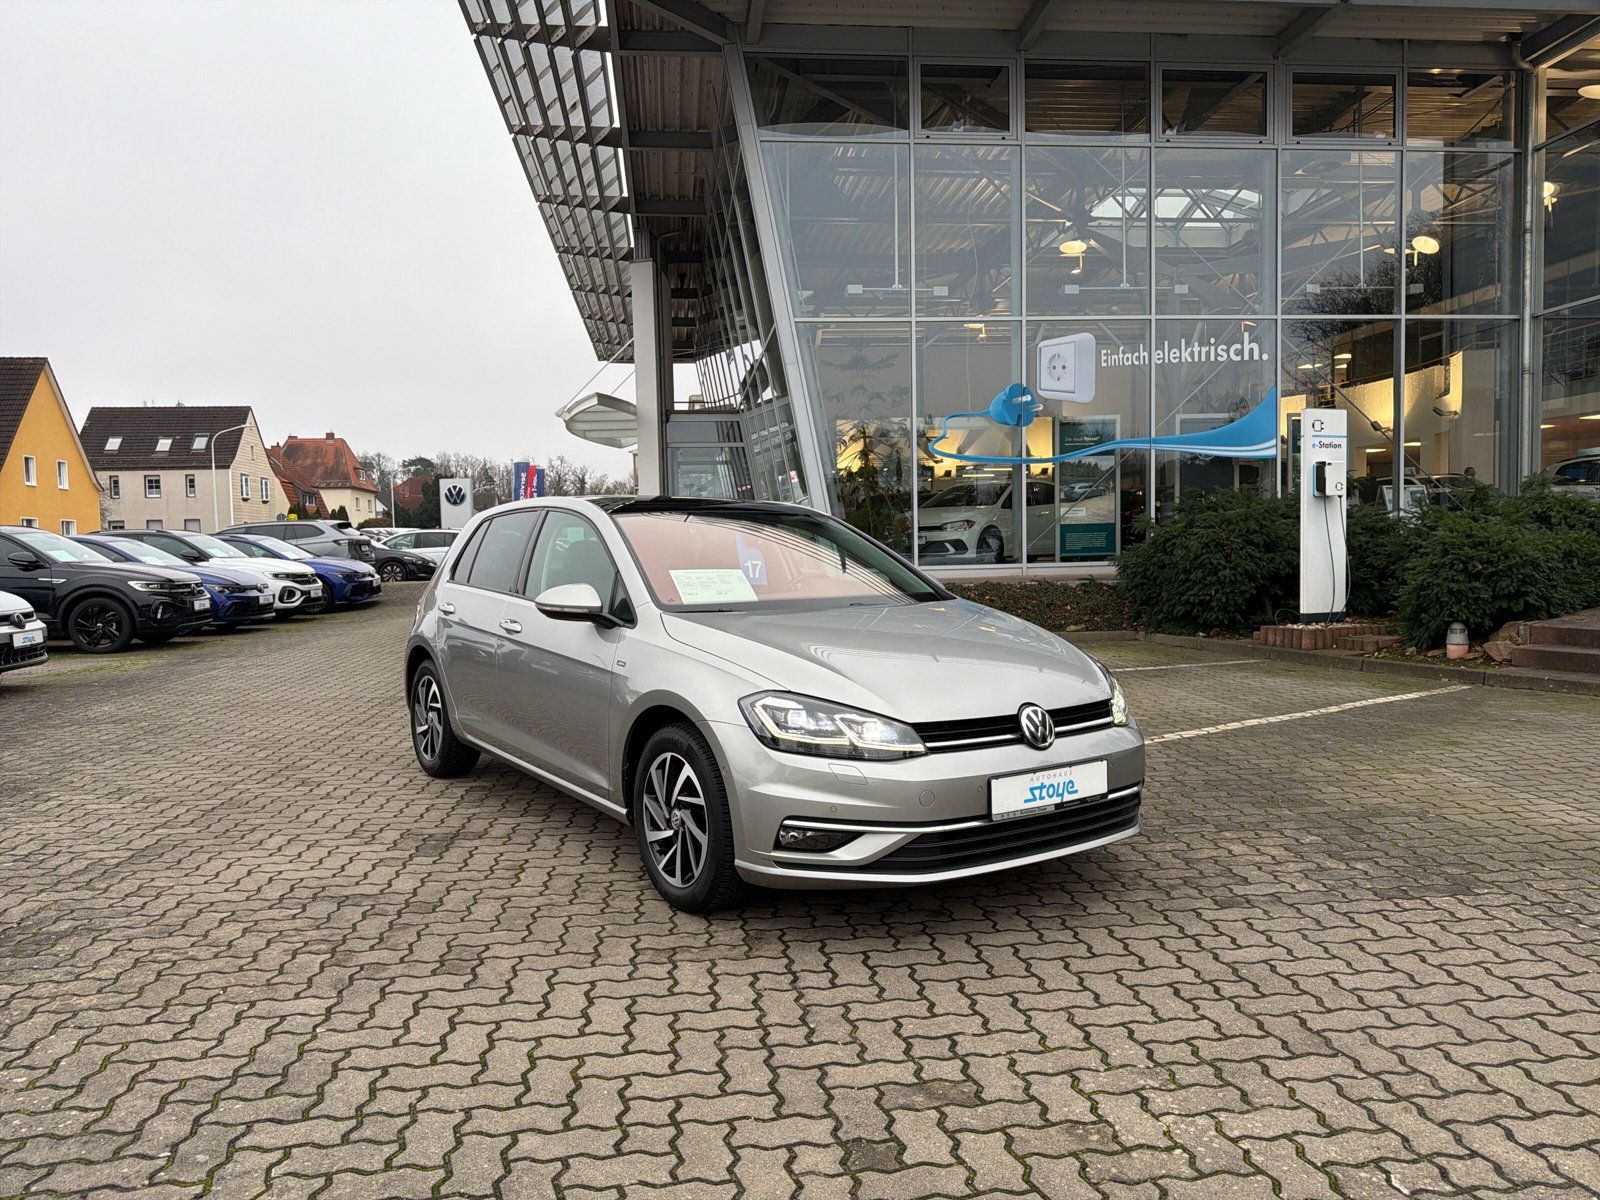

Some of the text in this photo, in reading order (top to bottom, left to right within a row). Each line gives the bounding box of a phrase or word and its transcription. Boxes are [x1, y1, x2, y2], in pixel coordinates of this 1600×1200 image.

[1101, 332, 1269, 367] Einfach elektrisch.
[1312, 440, 1342, 449] e-Station
[744, 560, 762, 578] 17
[1030, 770, 1073, 782] AUTOHAUS
